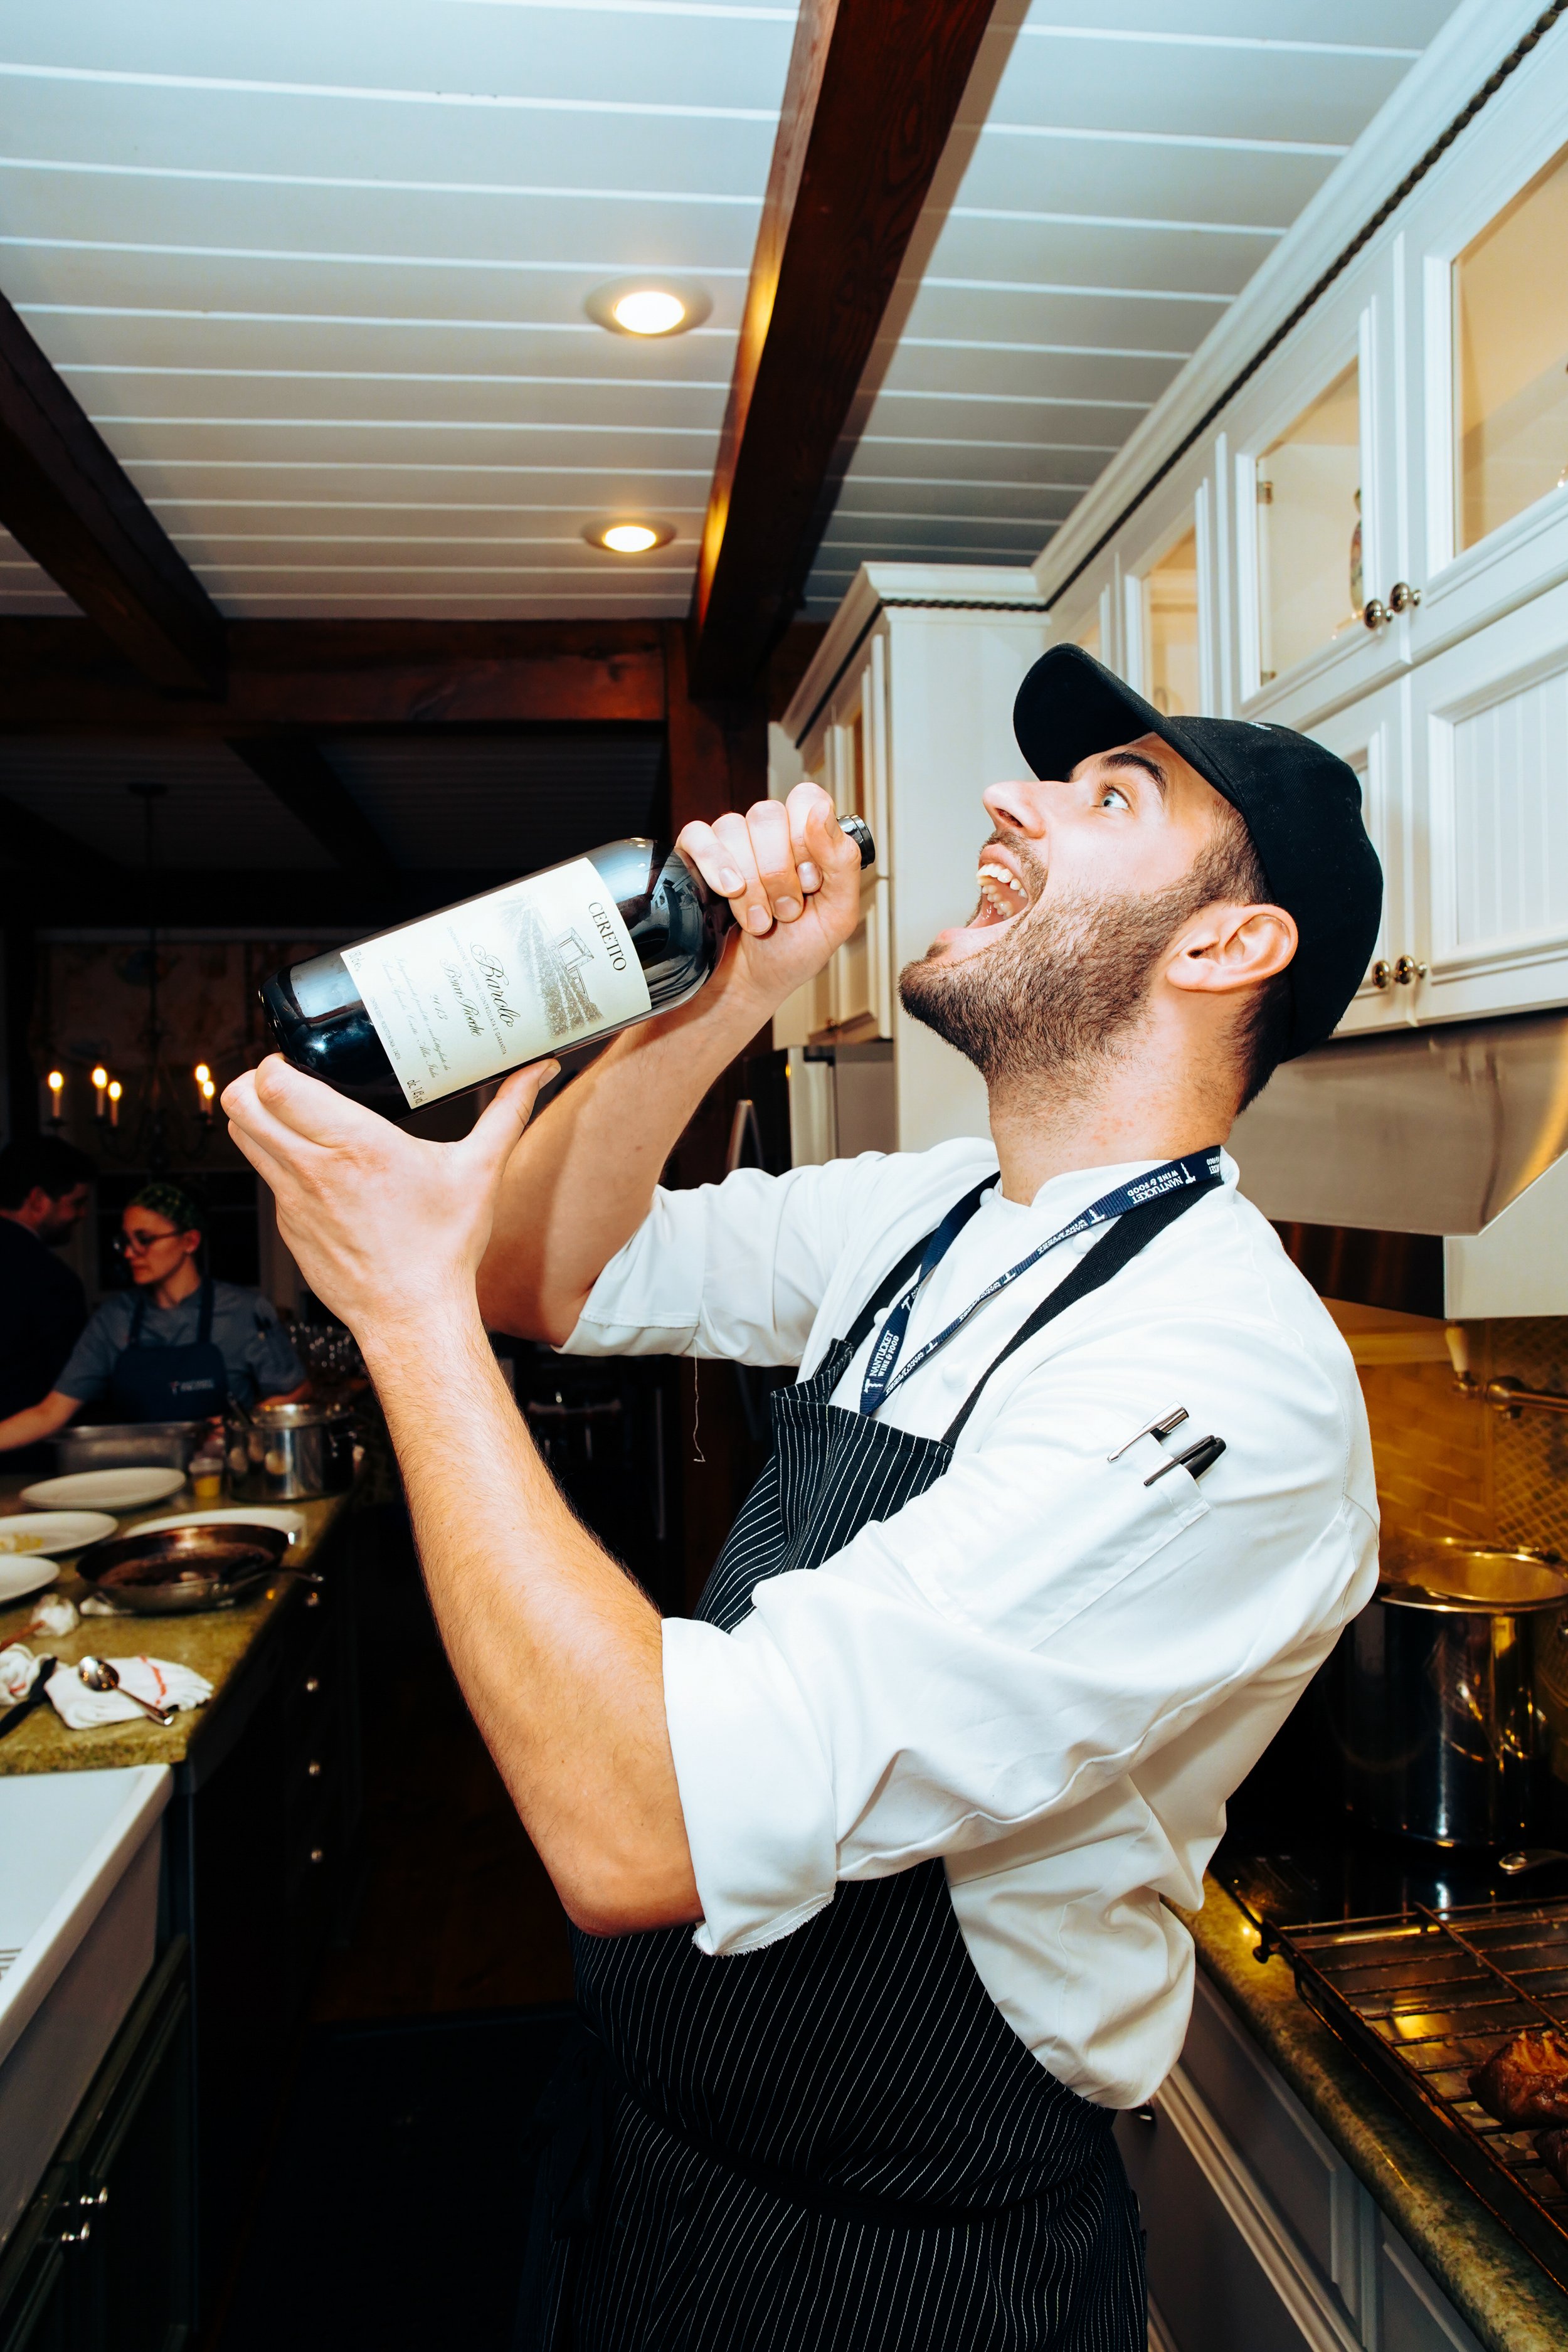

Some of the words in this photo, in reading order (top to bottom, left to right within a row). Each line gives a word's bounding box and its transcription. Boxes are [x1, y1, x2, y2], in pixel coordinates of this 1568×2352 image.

[588, 900, 627, 972] CERETTO
[469, 941, 521, 1027] Barolo
[428, 992, 449, 1020] 2013
[454, 994, 485, 1038] Rocche
[467, 968, 482, 992] ORIGINE
[477, 992, 497, 1027] CONTROLLATA
[494, 1031, 507, 1055] GARANTITA
[1126, 1181, 1150, 1197] FOOD
[1130, 1175, 1183, 1204] NANTUCKET
[1148, 1177, 1157, 1187] &
[1157, 1168, 1179, 1183] WINE
[869, 1329, 894, 1376] NANTUCKET
[884, 1352, 893, 1360] &
[887, 1335, 900, 1353] FOOD
[877, 1359, 890, 1377] WINE
